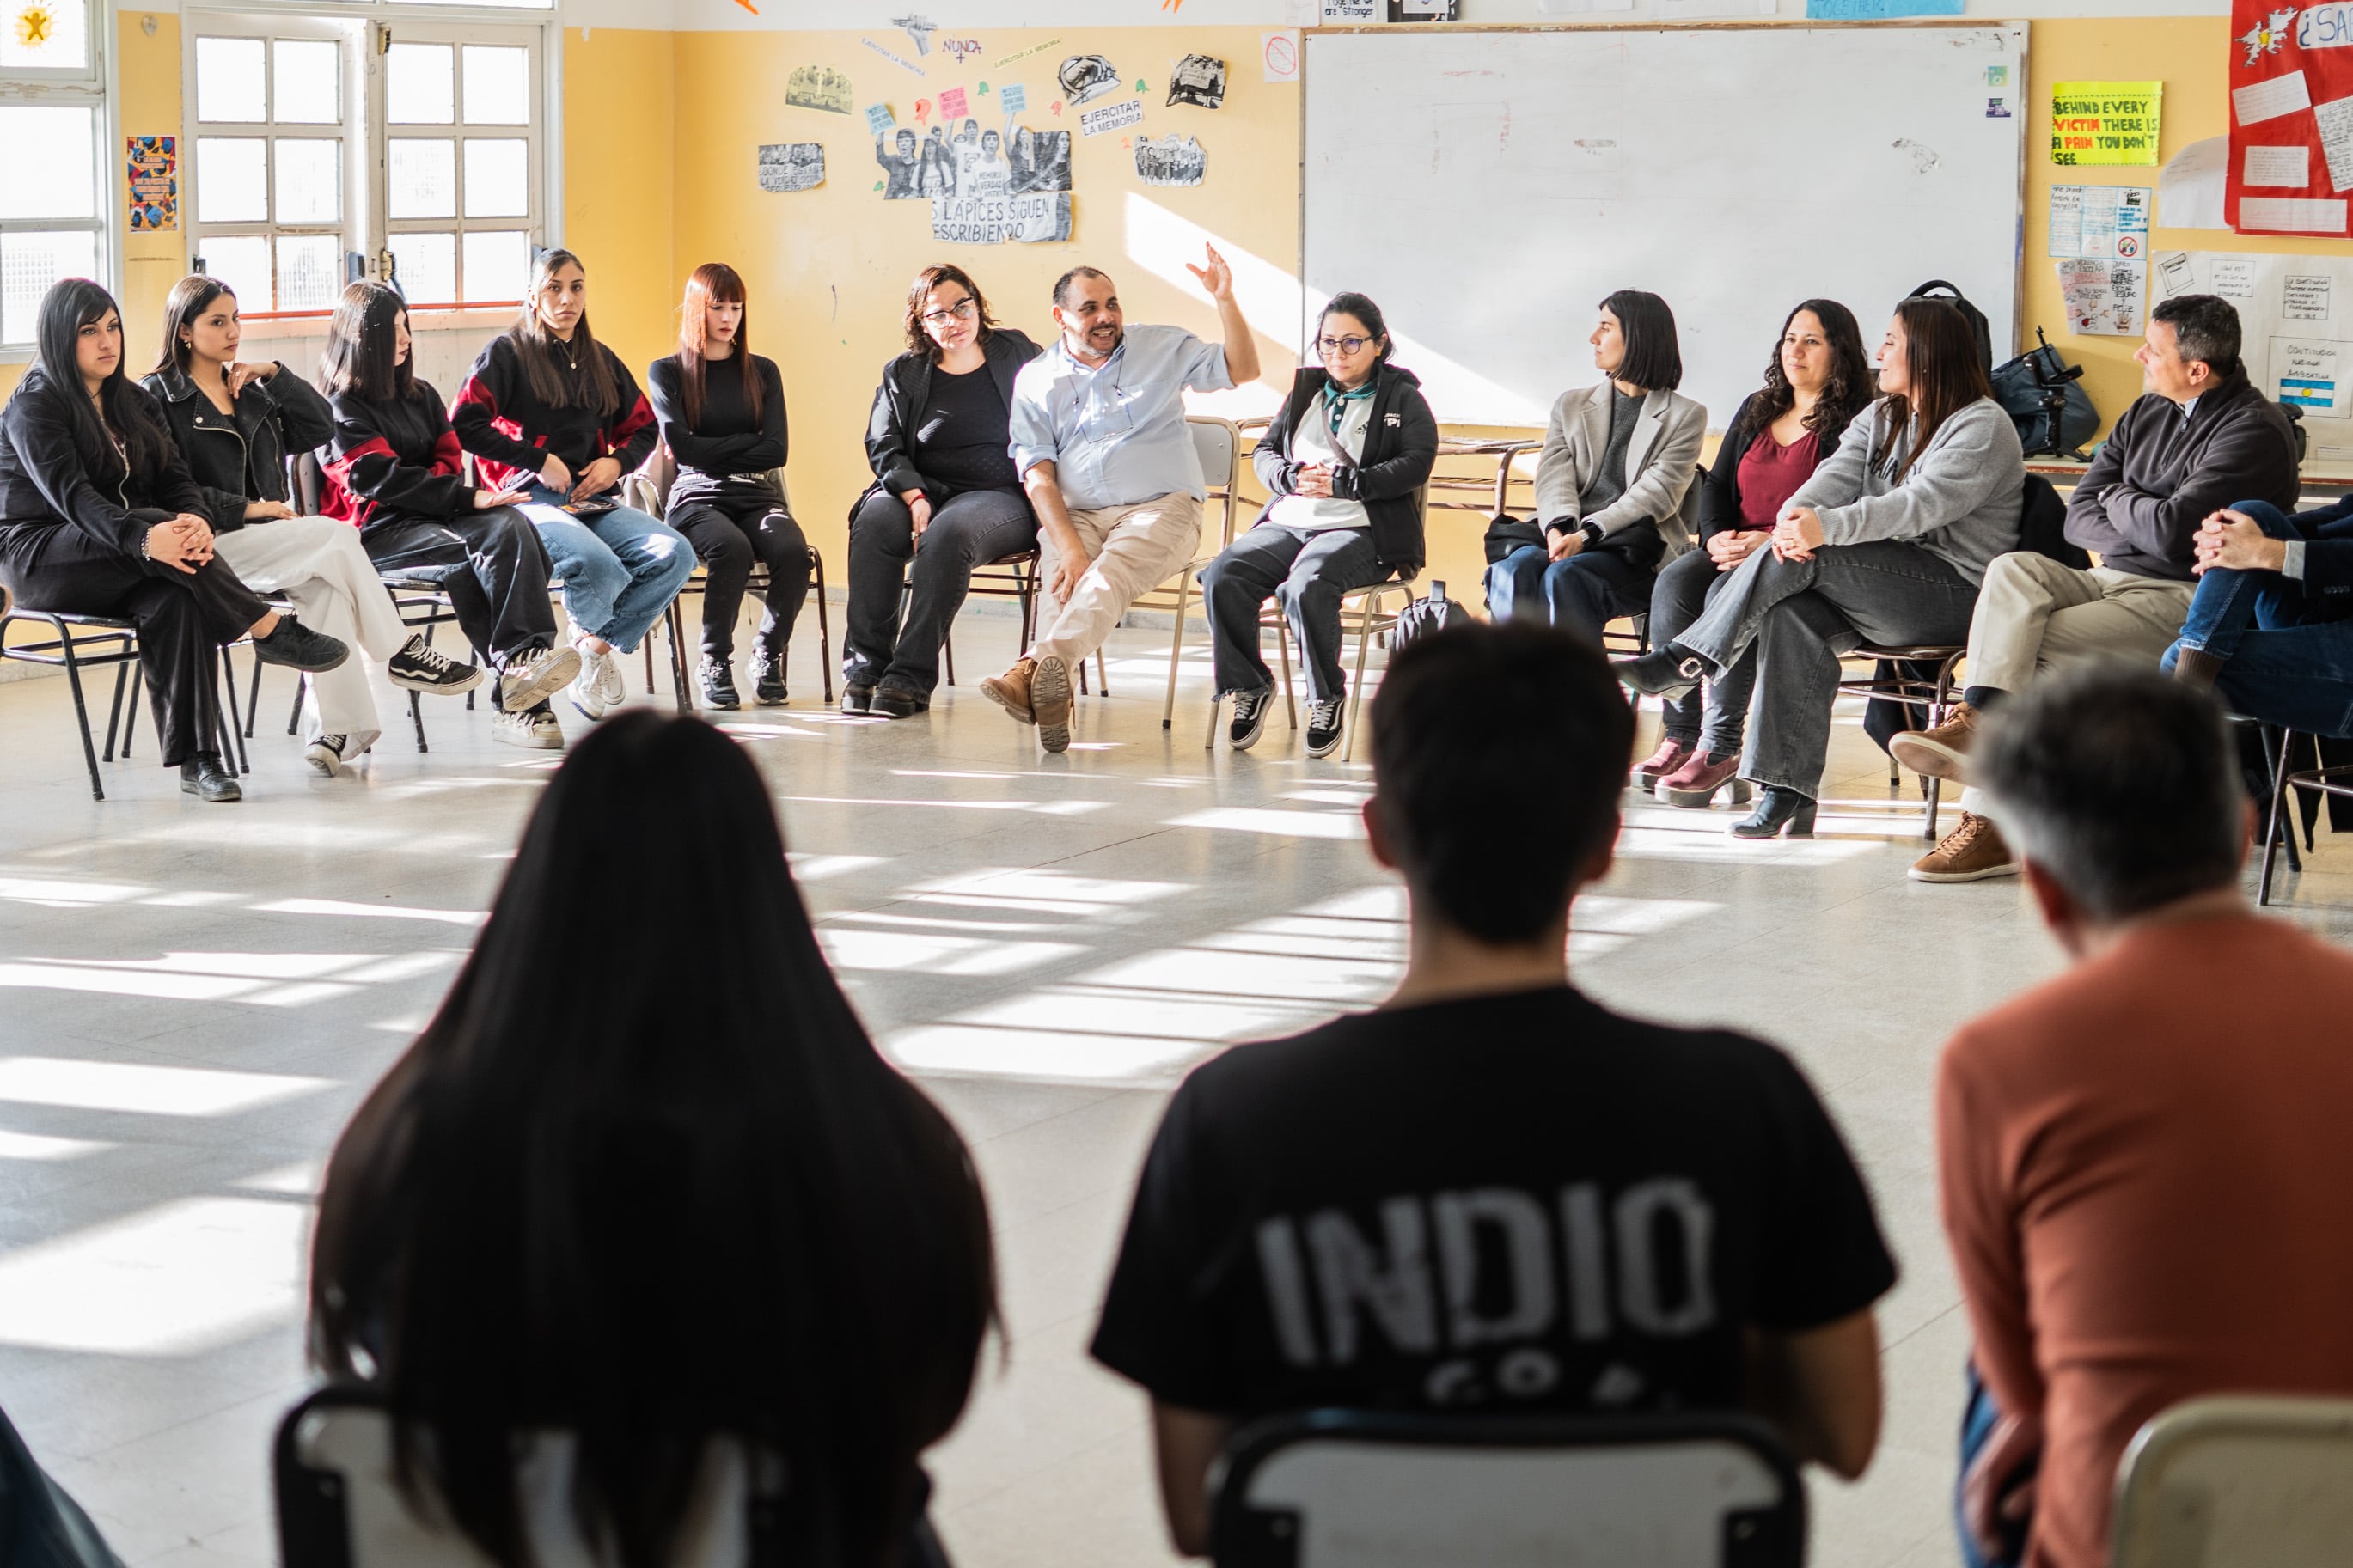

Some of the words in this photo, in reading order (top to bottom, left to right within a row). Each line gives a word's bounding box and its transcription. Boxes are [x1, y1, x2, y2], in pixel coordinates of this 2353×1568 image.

[2299, 7, 2353, 47] ¿SA
[942, 38, 981, 54] NUNCA
[1080, 100, 1140, 125] EJERCITAR
[2053, 101, 2099, 115] BEHIND
[2102, 101, 2148, 114] EVERY
[1083, 125, 1097, 136] LA
[1097, 113, 1142, 132] MEMORIA
[2053, 119, 2100, 131] VICTIM
[2103, 118, 2142, 131] THERE
[2146, 118, 2159, 131] IS
[2052, 137, 2062, 149] A
[2064, 137, 2093, 149] PAIN
[2096, 136, 2121, 149] YOU
[2054, 152, 2077, 165] SEE
[944, 198, 1005, 222] LÁPICES
[1008, 198, 1050, 221] SIGUEN
[932, 222, 1024, 242] ESCRIBIENDO
[1256, 1174, 1719, 1366] INDIO
